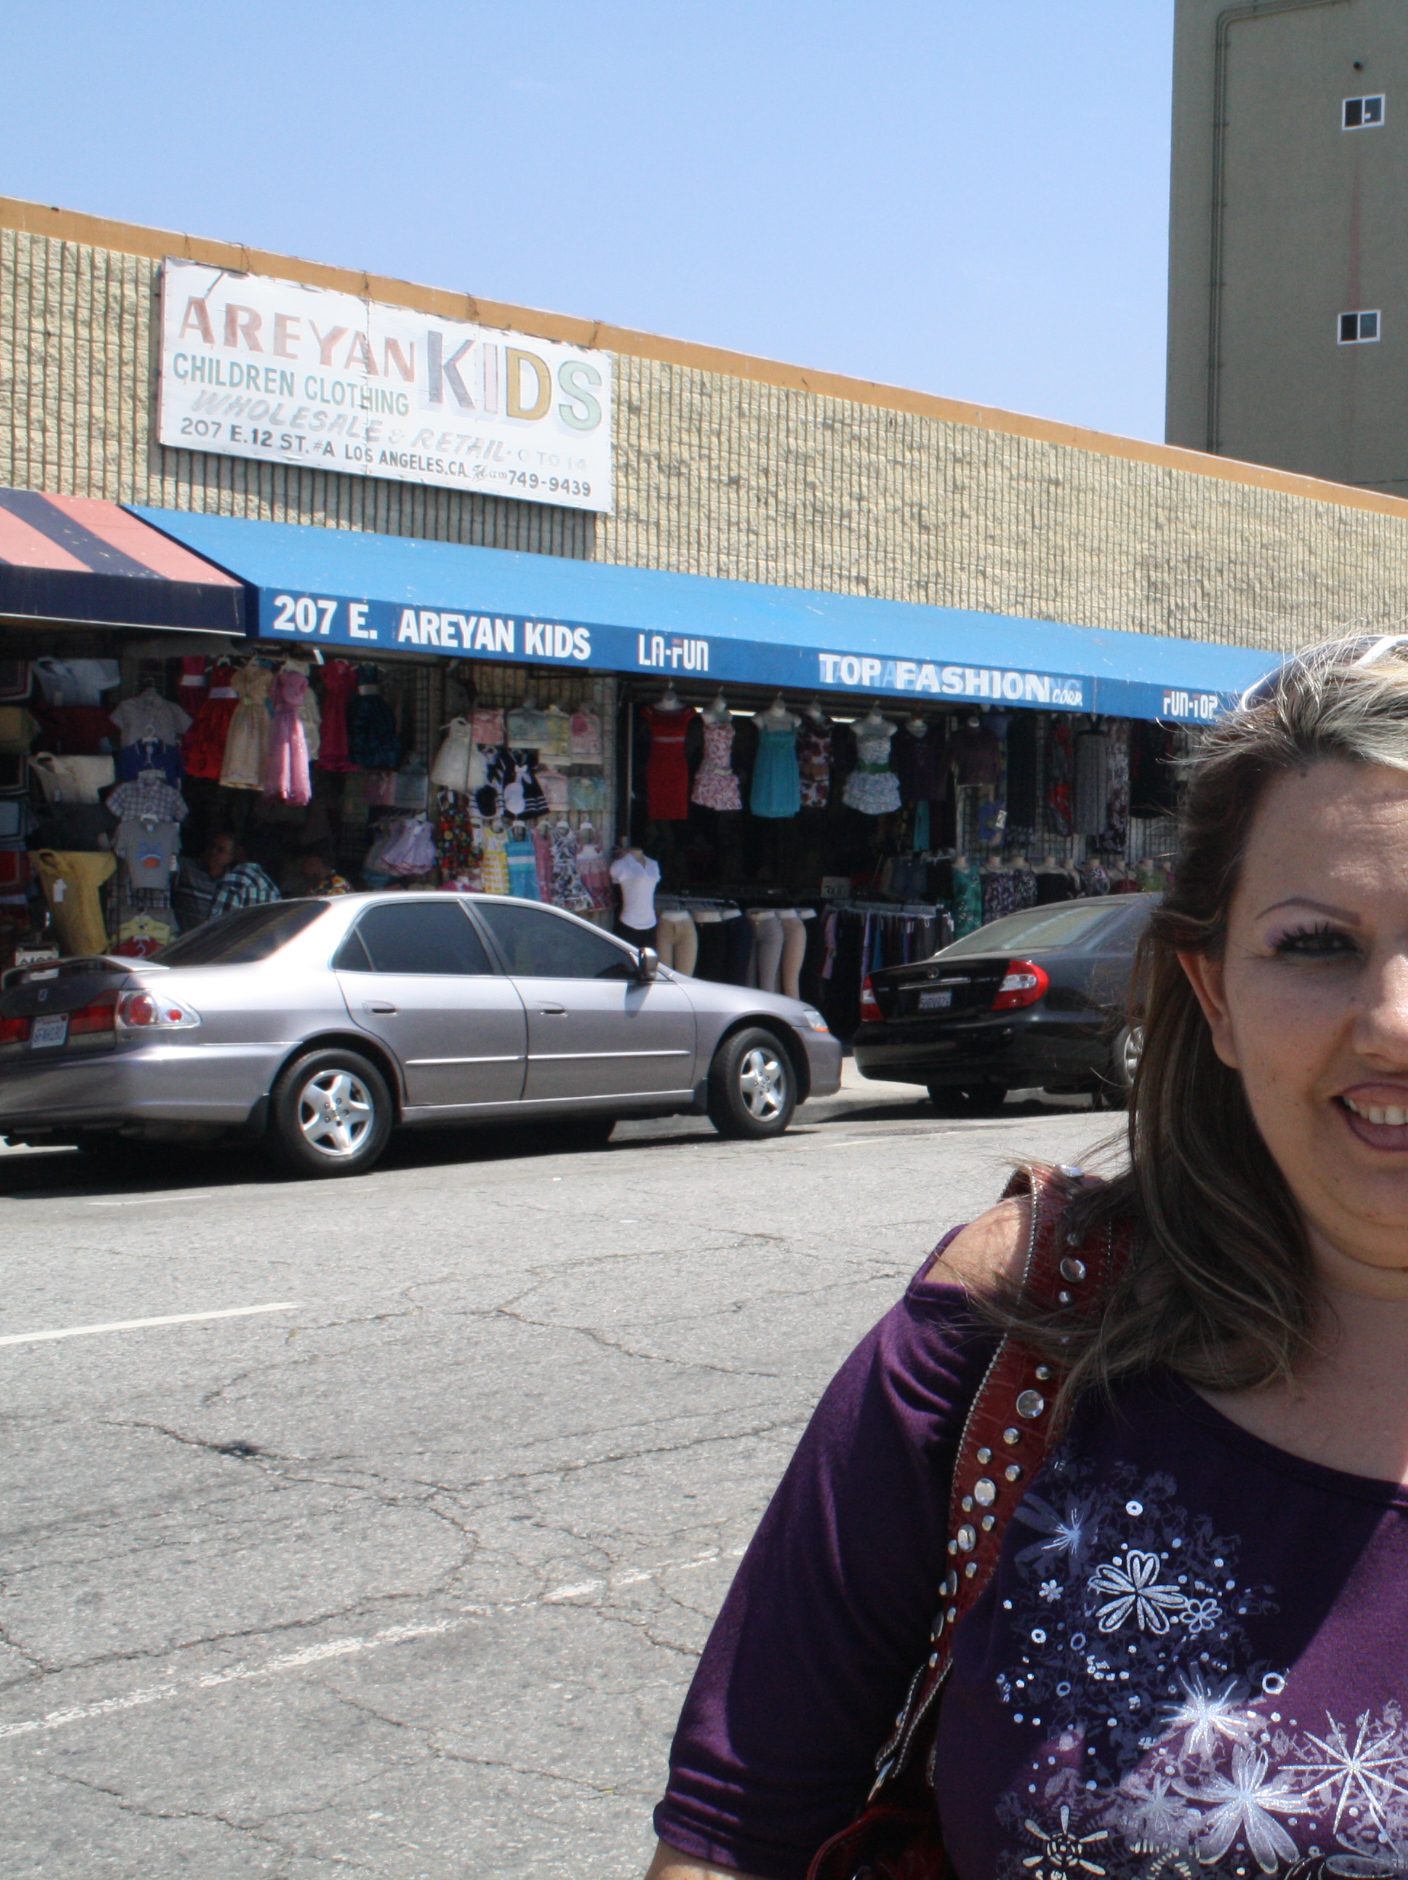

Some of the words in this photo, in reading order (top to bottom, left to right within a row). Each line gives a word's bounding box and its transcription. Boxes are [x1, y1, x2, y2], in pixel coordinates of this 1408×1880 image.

[173, 353, 295, 397] CHILDREN
[304, 376, 410, 416] CLOTHING
[179, 296, 415, 383] AREYAN
[427, 330, 603, 432] KIDS
[181, 417, 222, 439] 207
[345, 444, 374, 464] LOS
[191, 390, 383, 442] WHOLESALE
[273, 595, 337, 634] 207
[350, 601, 377, 640] E.
[398, 609, 515, 653] AREYAN
[525, 622, 592, 661] KIDS
[818, 653, 881, 687] TOP
[895, 661, 1051, 703] FASHION
